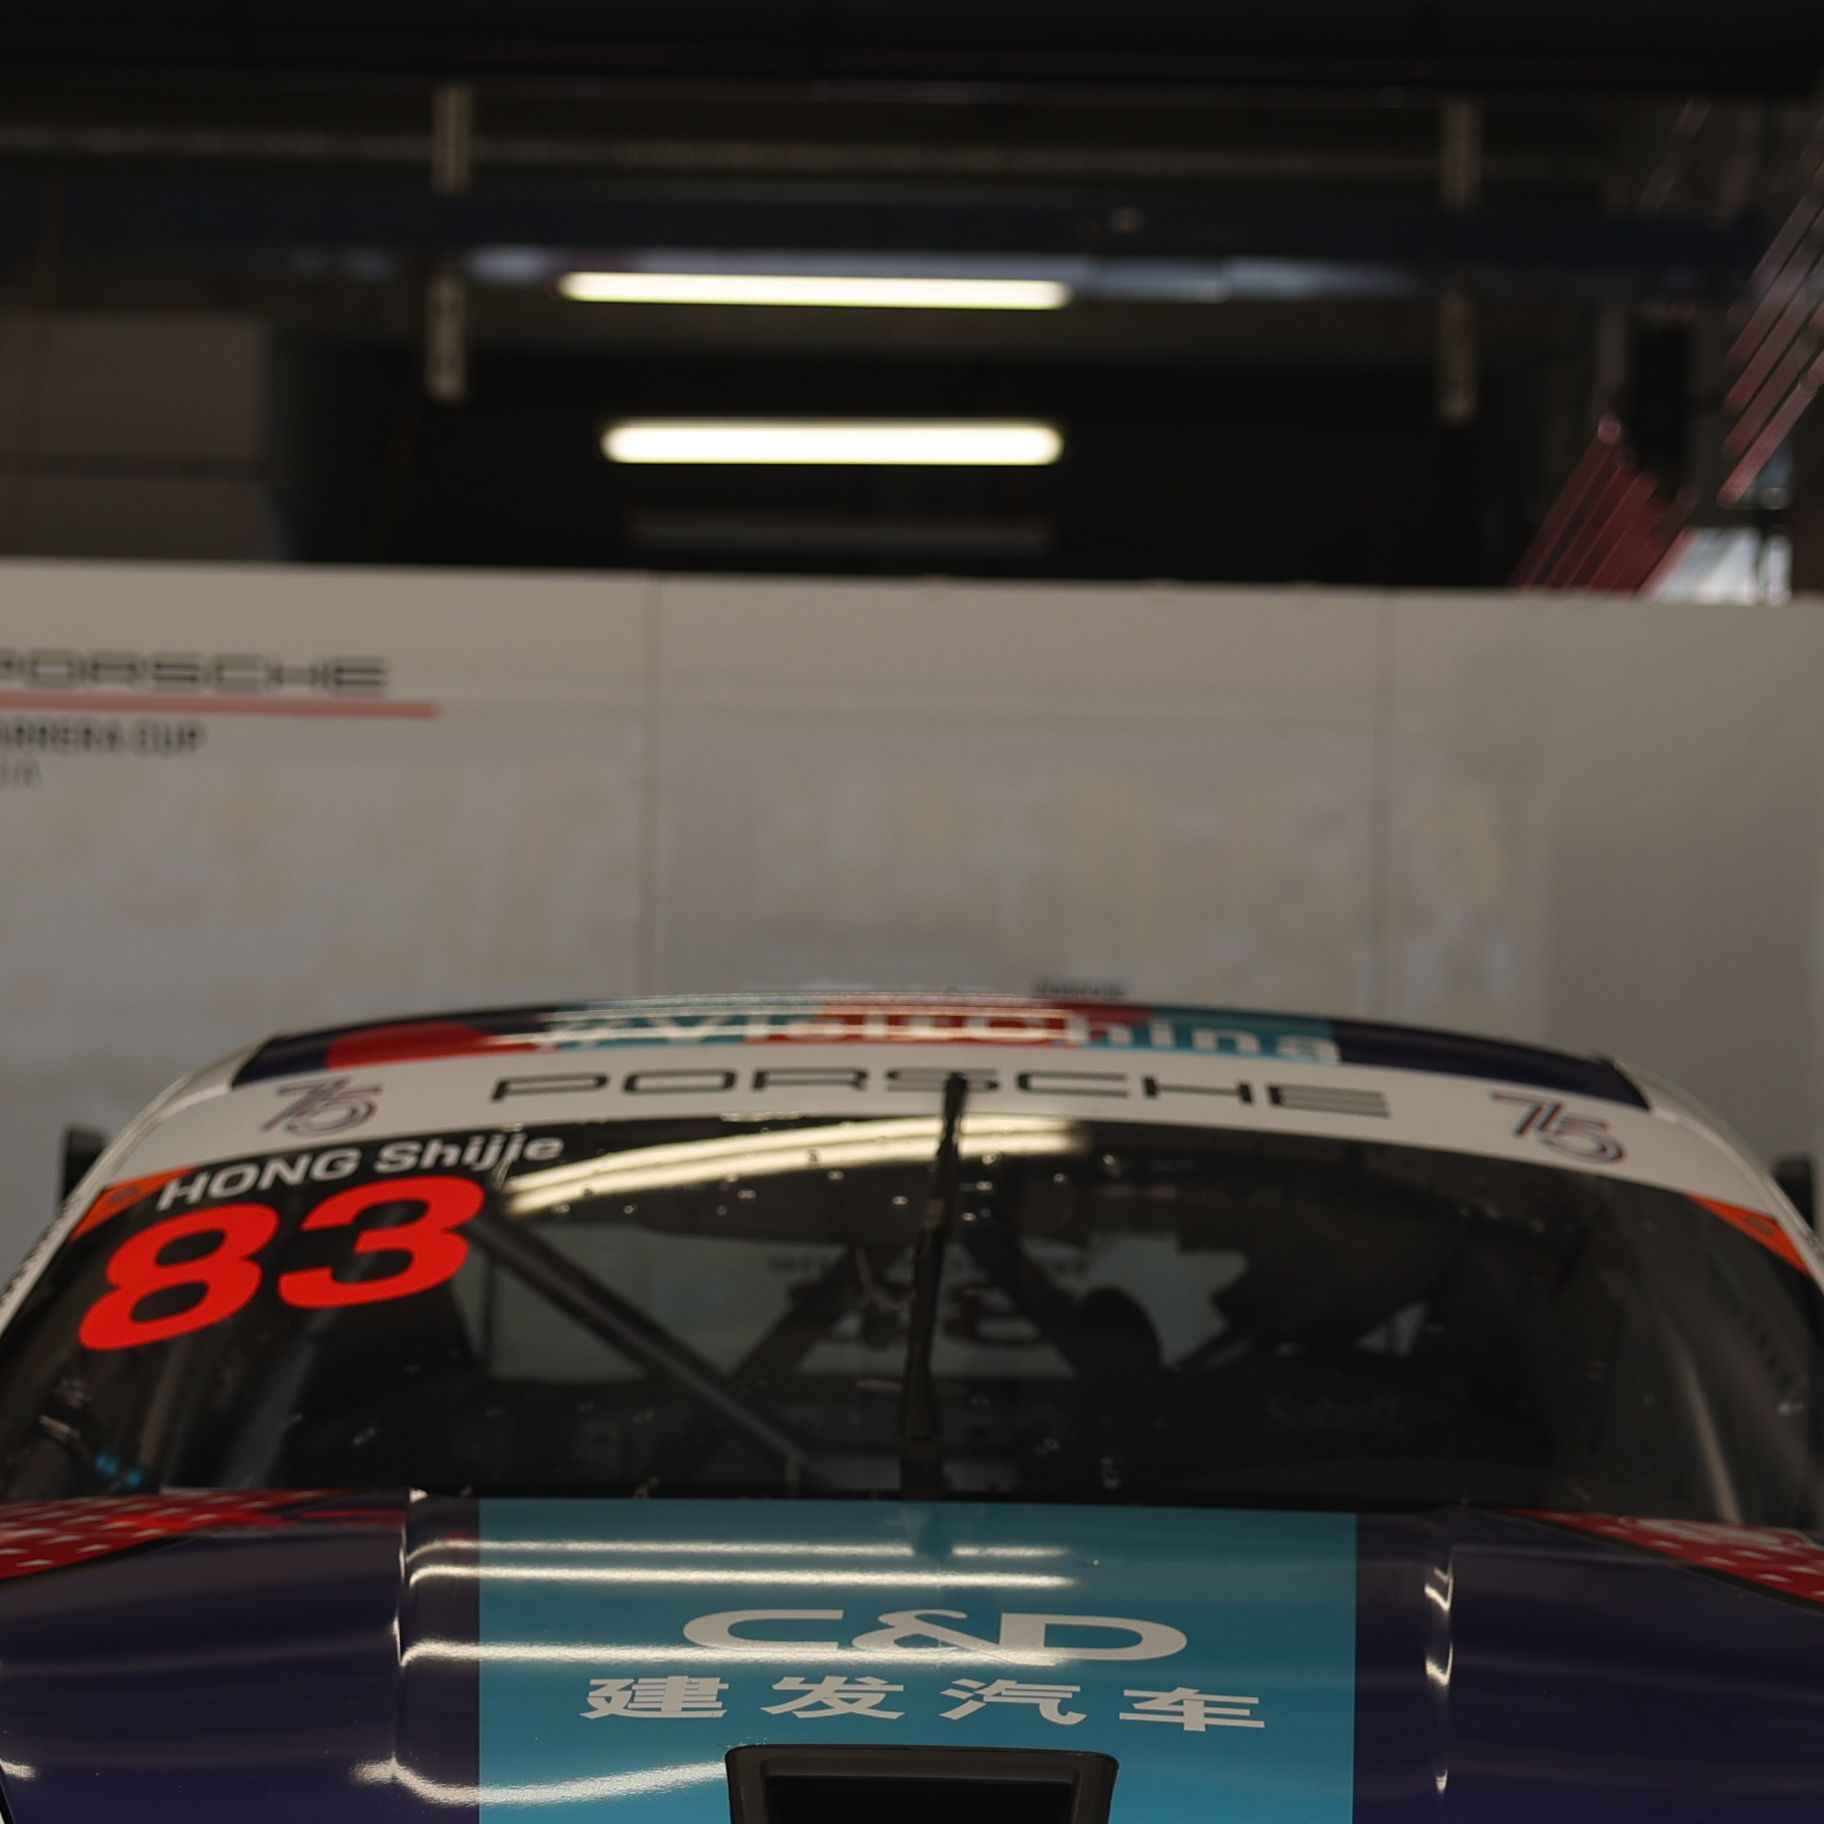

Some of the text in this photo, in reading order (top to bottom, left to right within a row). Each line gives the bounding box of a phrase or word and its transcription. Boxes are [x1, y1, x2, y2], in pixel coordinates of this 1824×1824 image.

[491, 1066, 1390, 1118] PORSCHE
[155, 1132, 566, 1212] HONG Shijie
[78, 1175, 486, 1352] 83
[682, 1608, 1188, 1667] C&D
[579, 1674, 1266, 1733] 建发汽车
